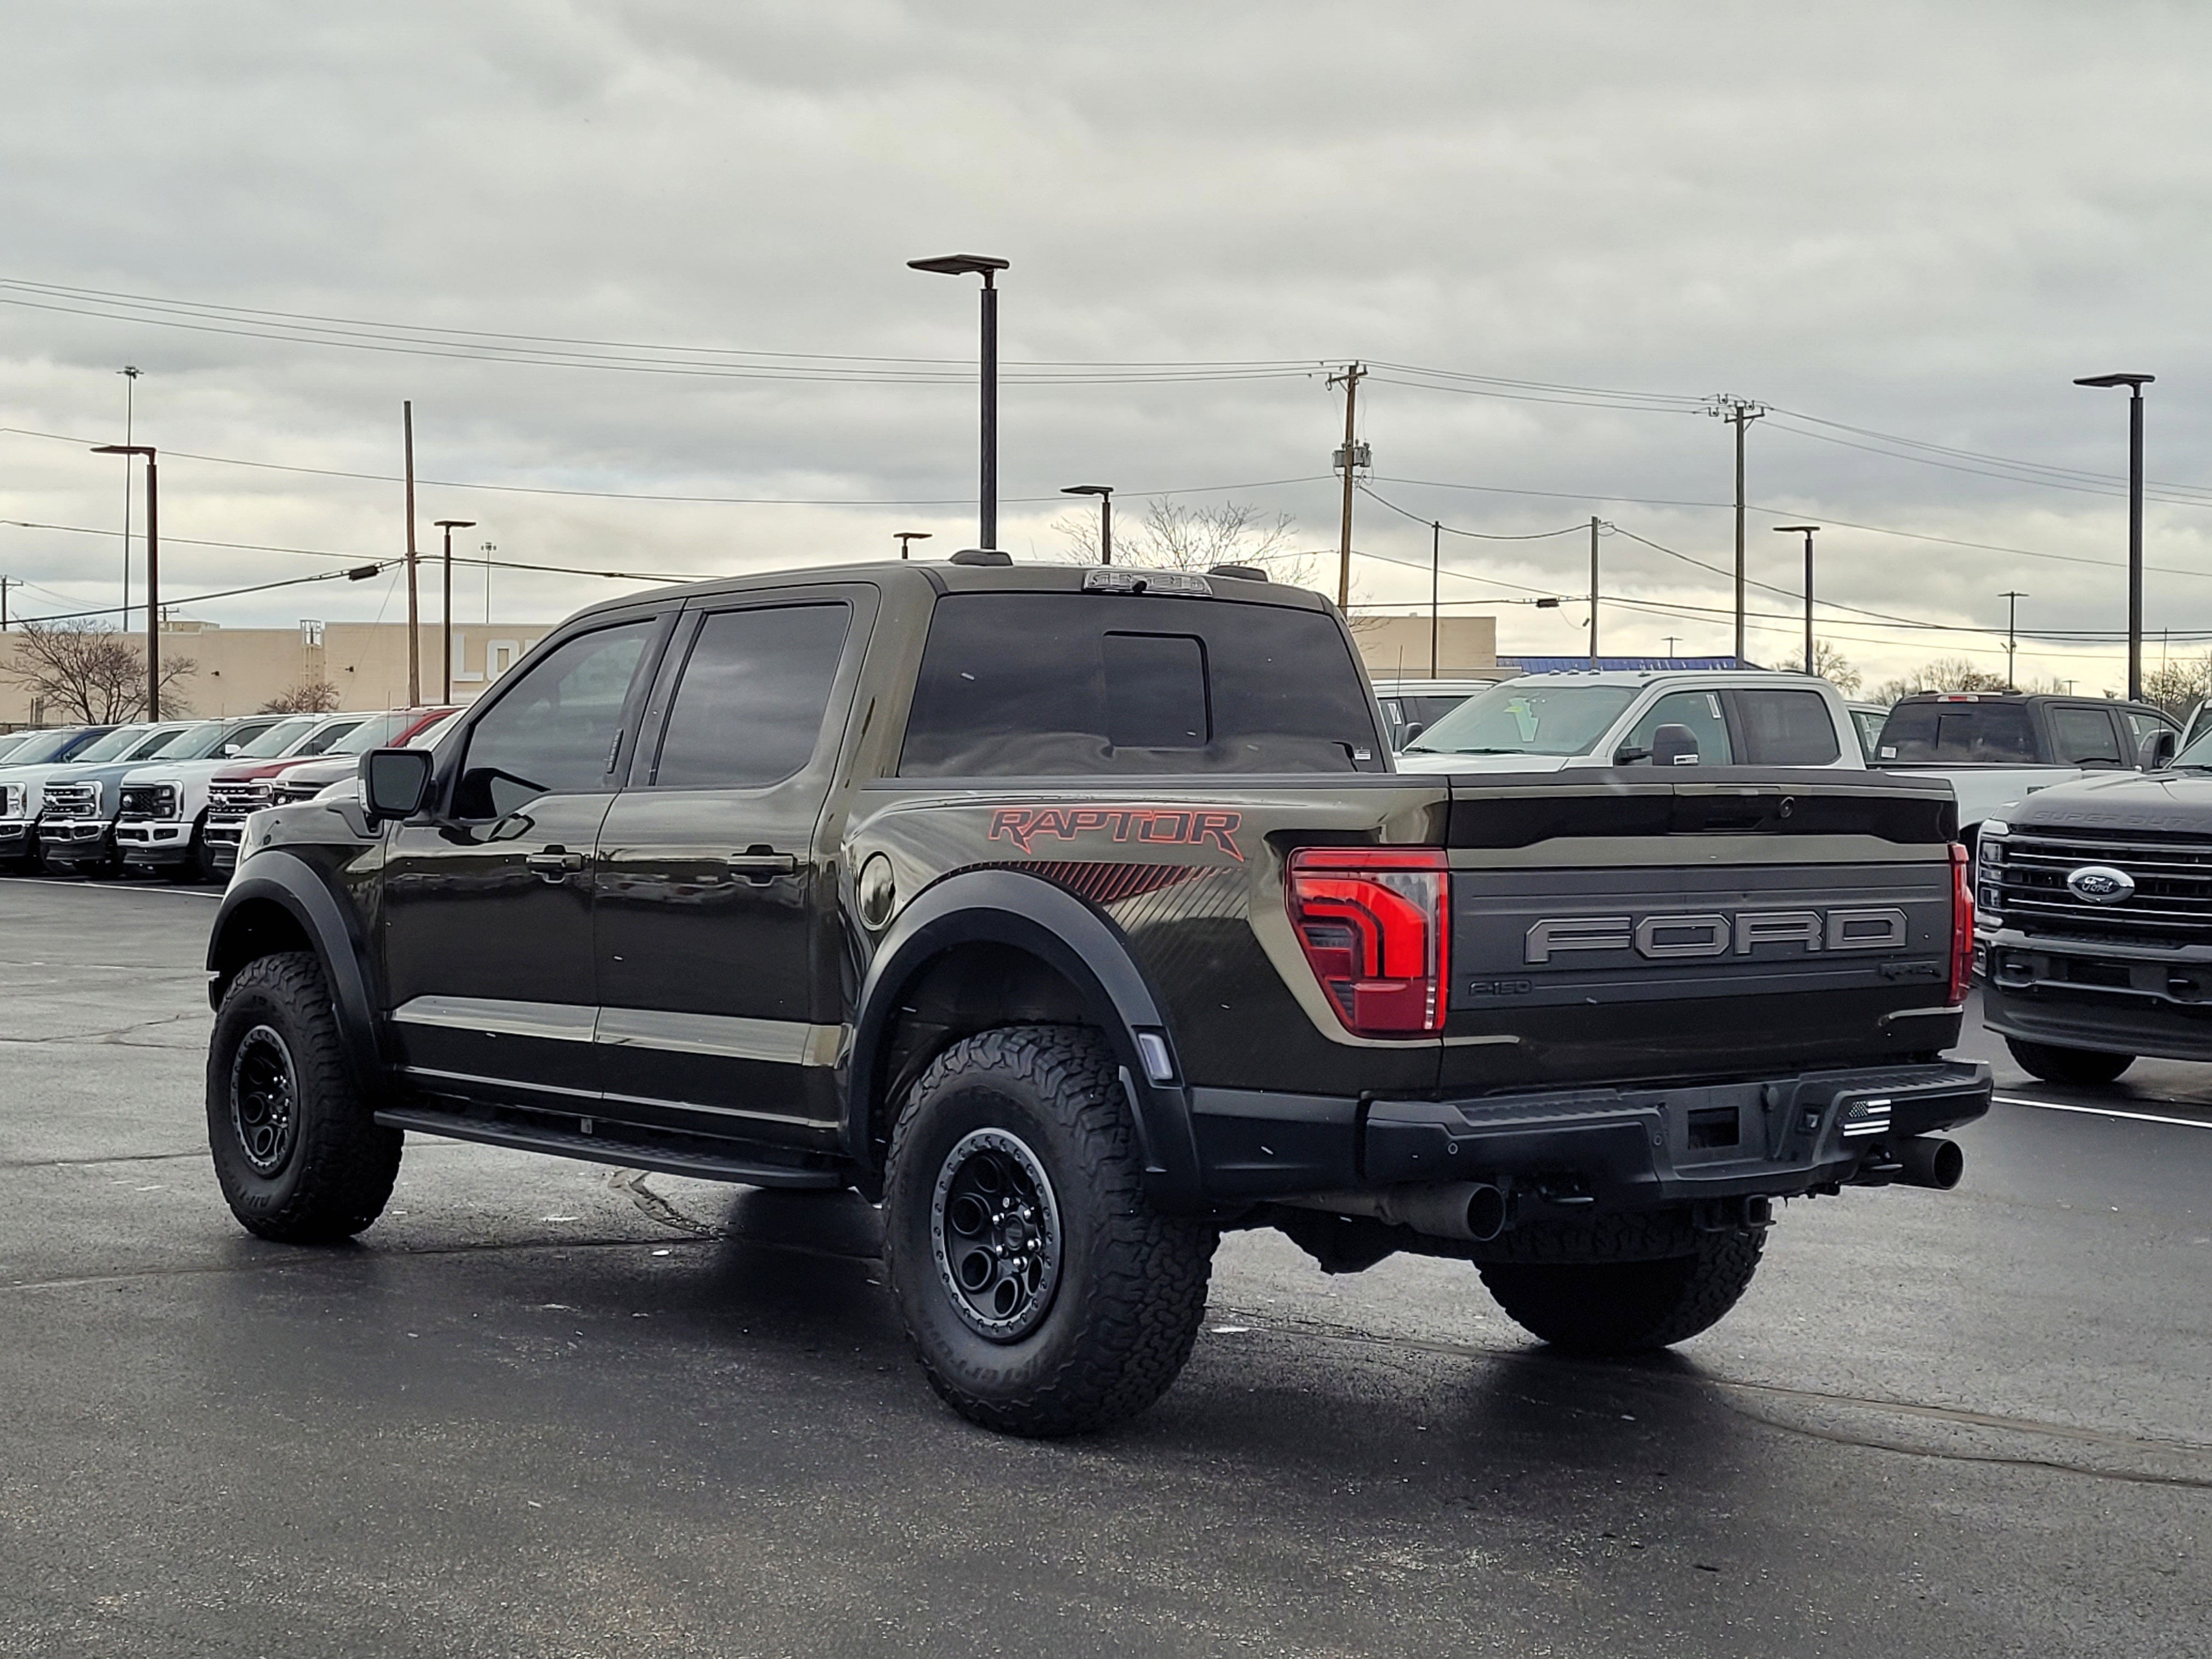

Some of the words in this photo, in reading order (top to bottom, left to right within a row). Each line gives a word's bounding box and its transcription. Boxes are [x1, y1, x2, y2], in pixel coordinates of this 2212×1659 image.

[453, 634, 538, 682] LO
[988, 809, 1244, 863] RAPTOR
[2033, 810, 2119, 823] SUPER
[2081, 876, 2113, 893] Ford
[1524, 907, 1908, 964] FORD
